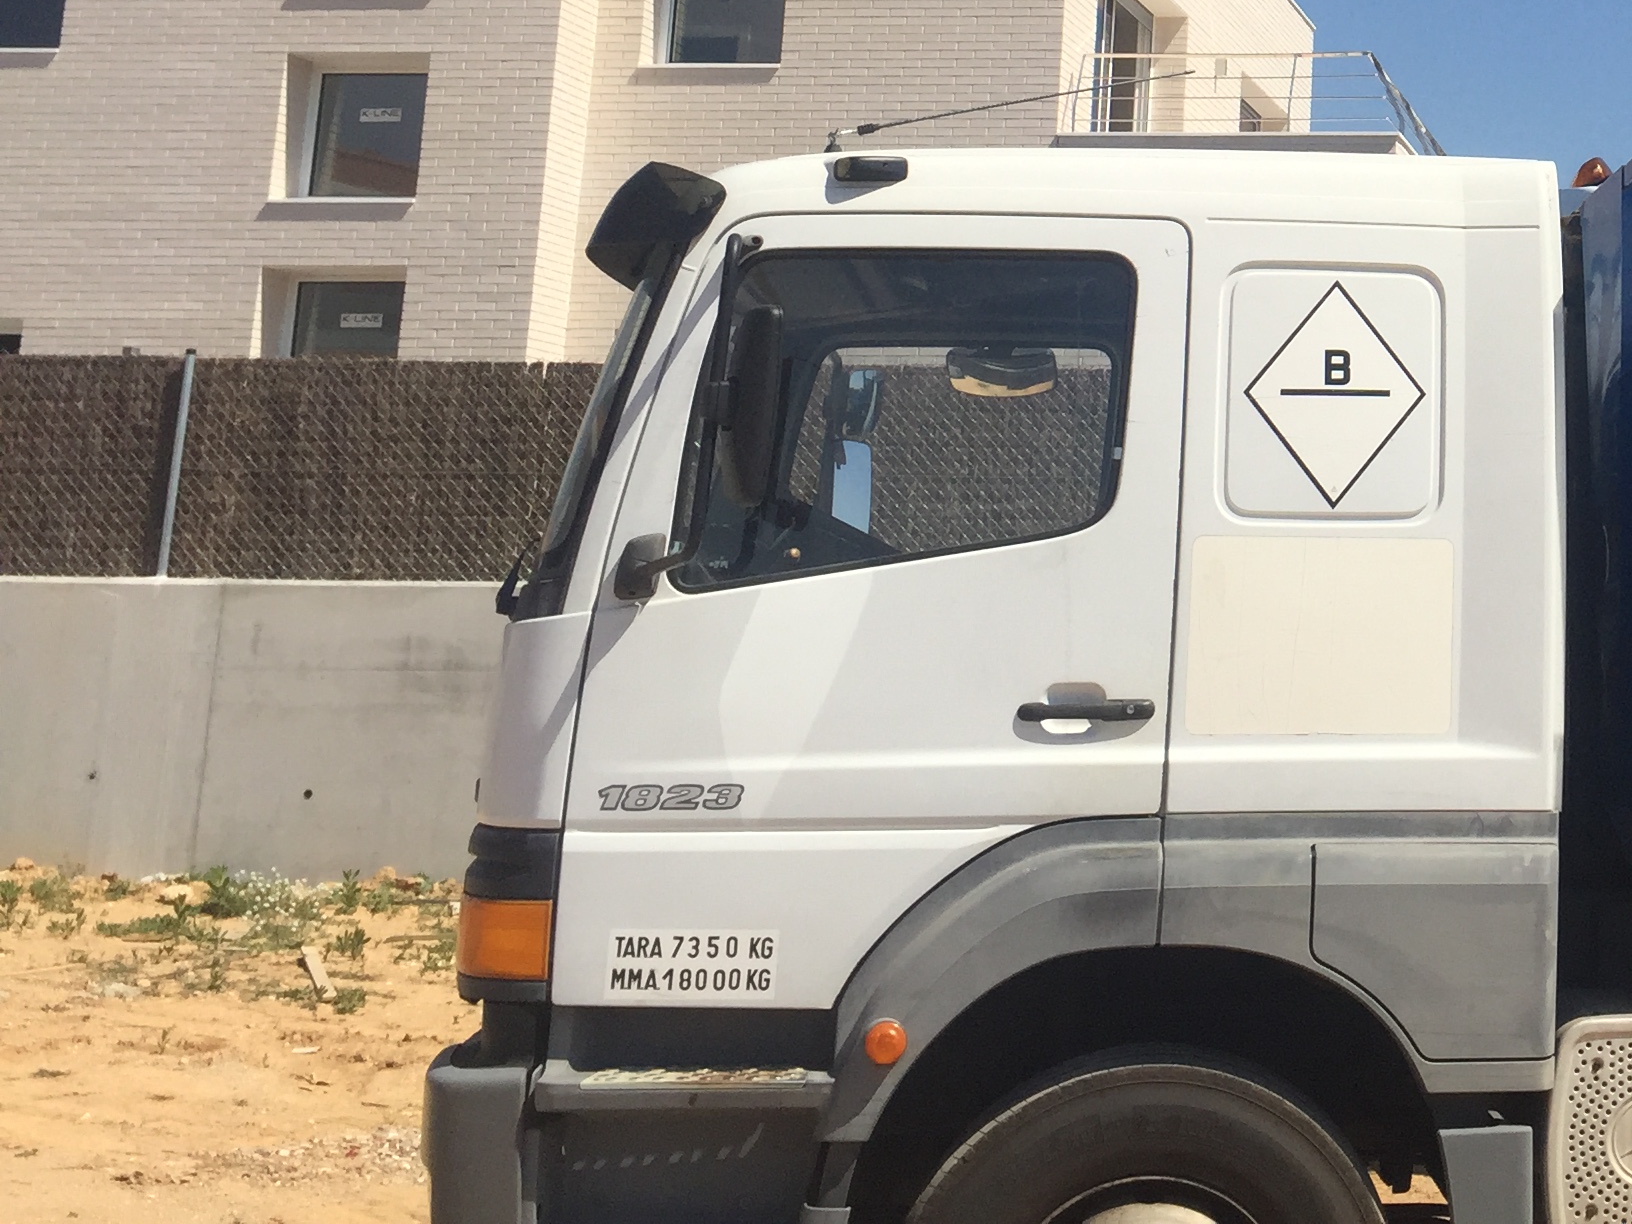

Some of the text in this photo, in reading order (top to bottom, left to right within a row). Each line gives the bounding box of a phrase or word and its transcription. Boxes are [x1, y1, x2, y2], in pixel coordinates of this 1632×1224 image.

[1324, 349, 1351, 385] B
[597, 783, 745, 811] 1823
[615, 935, 774, 959] TARA 7350 KG
[662, 968, 742, 991] 18000
[746, 969, 771, 991] KG
